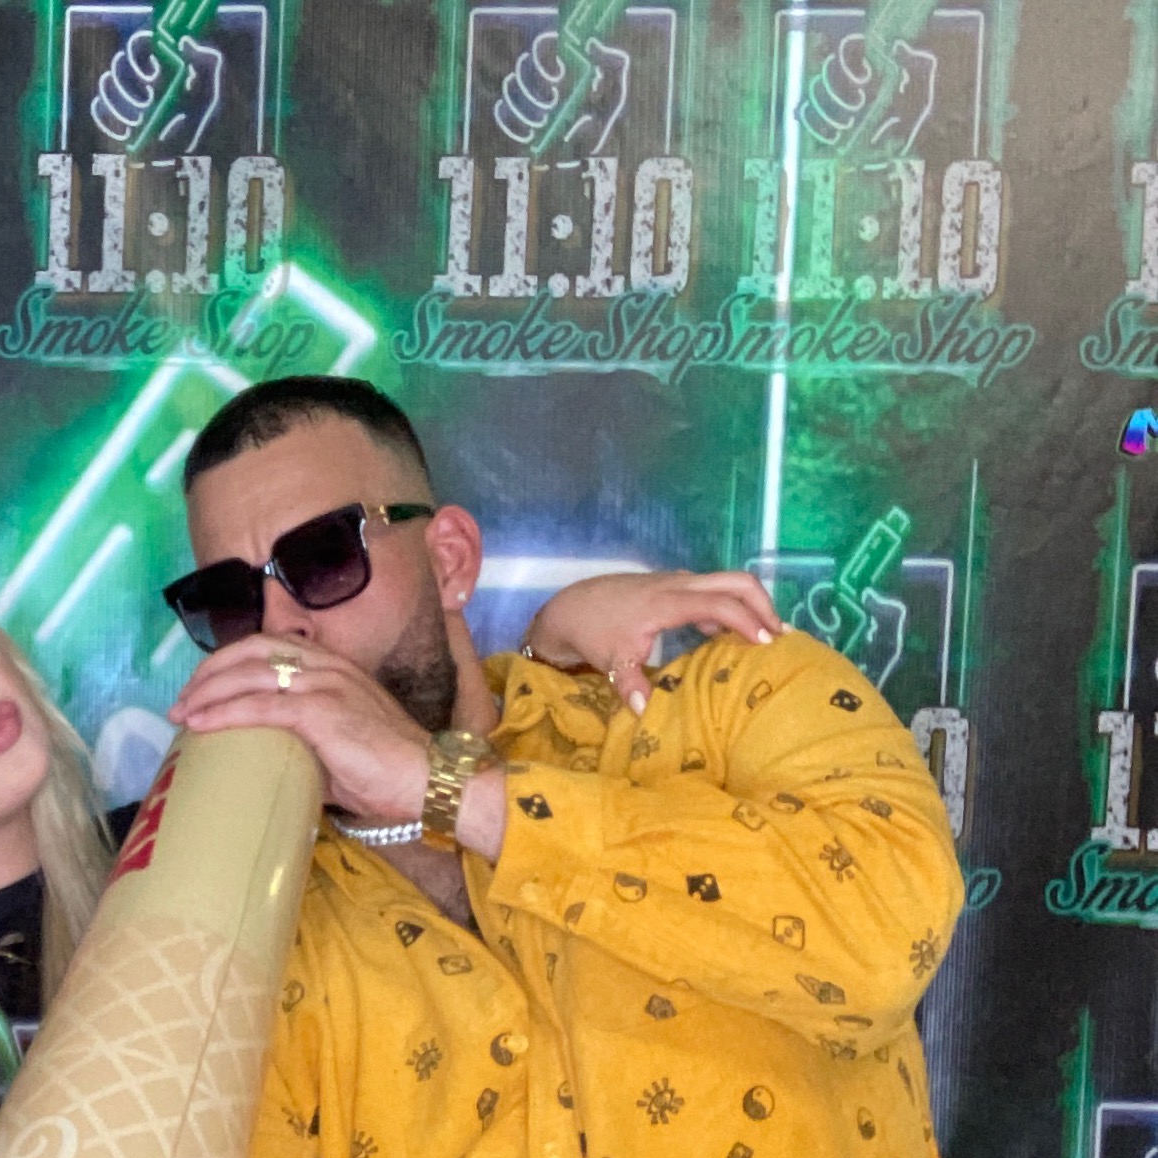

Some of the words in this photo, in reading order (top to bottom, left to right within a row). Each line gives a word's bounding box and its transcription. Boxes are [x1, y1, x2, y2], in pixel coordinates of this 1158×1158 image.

[34, 153, 285, 294] 11:10
[433, 156, 693, 297] 11:10
[736, 158, 1002, 300] 11:10
[392, 288, 584, 364] Smoke
[585, 290, 724, 385] Shop
[698, 290, 892, 366] Smoke
[892, 292, 1037, 389] Shop
